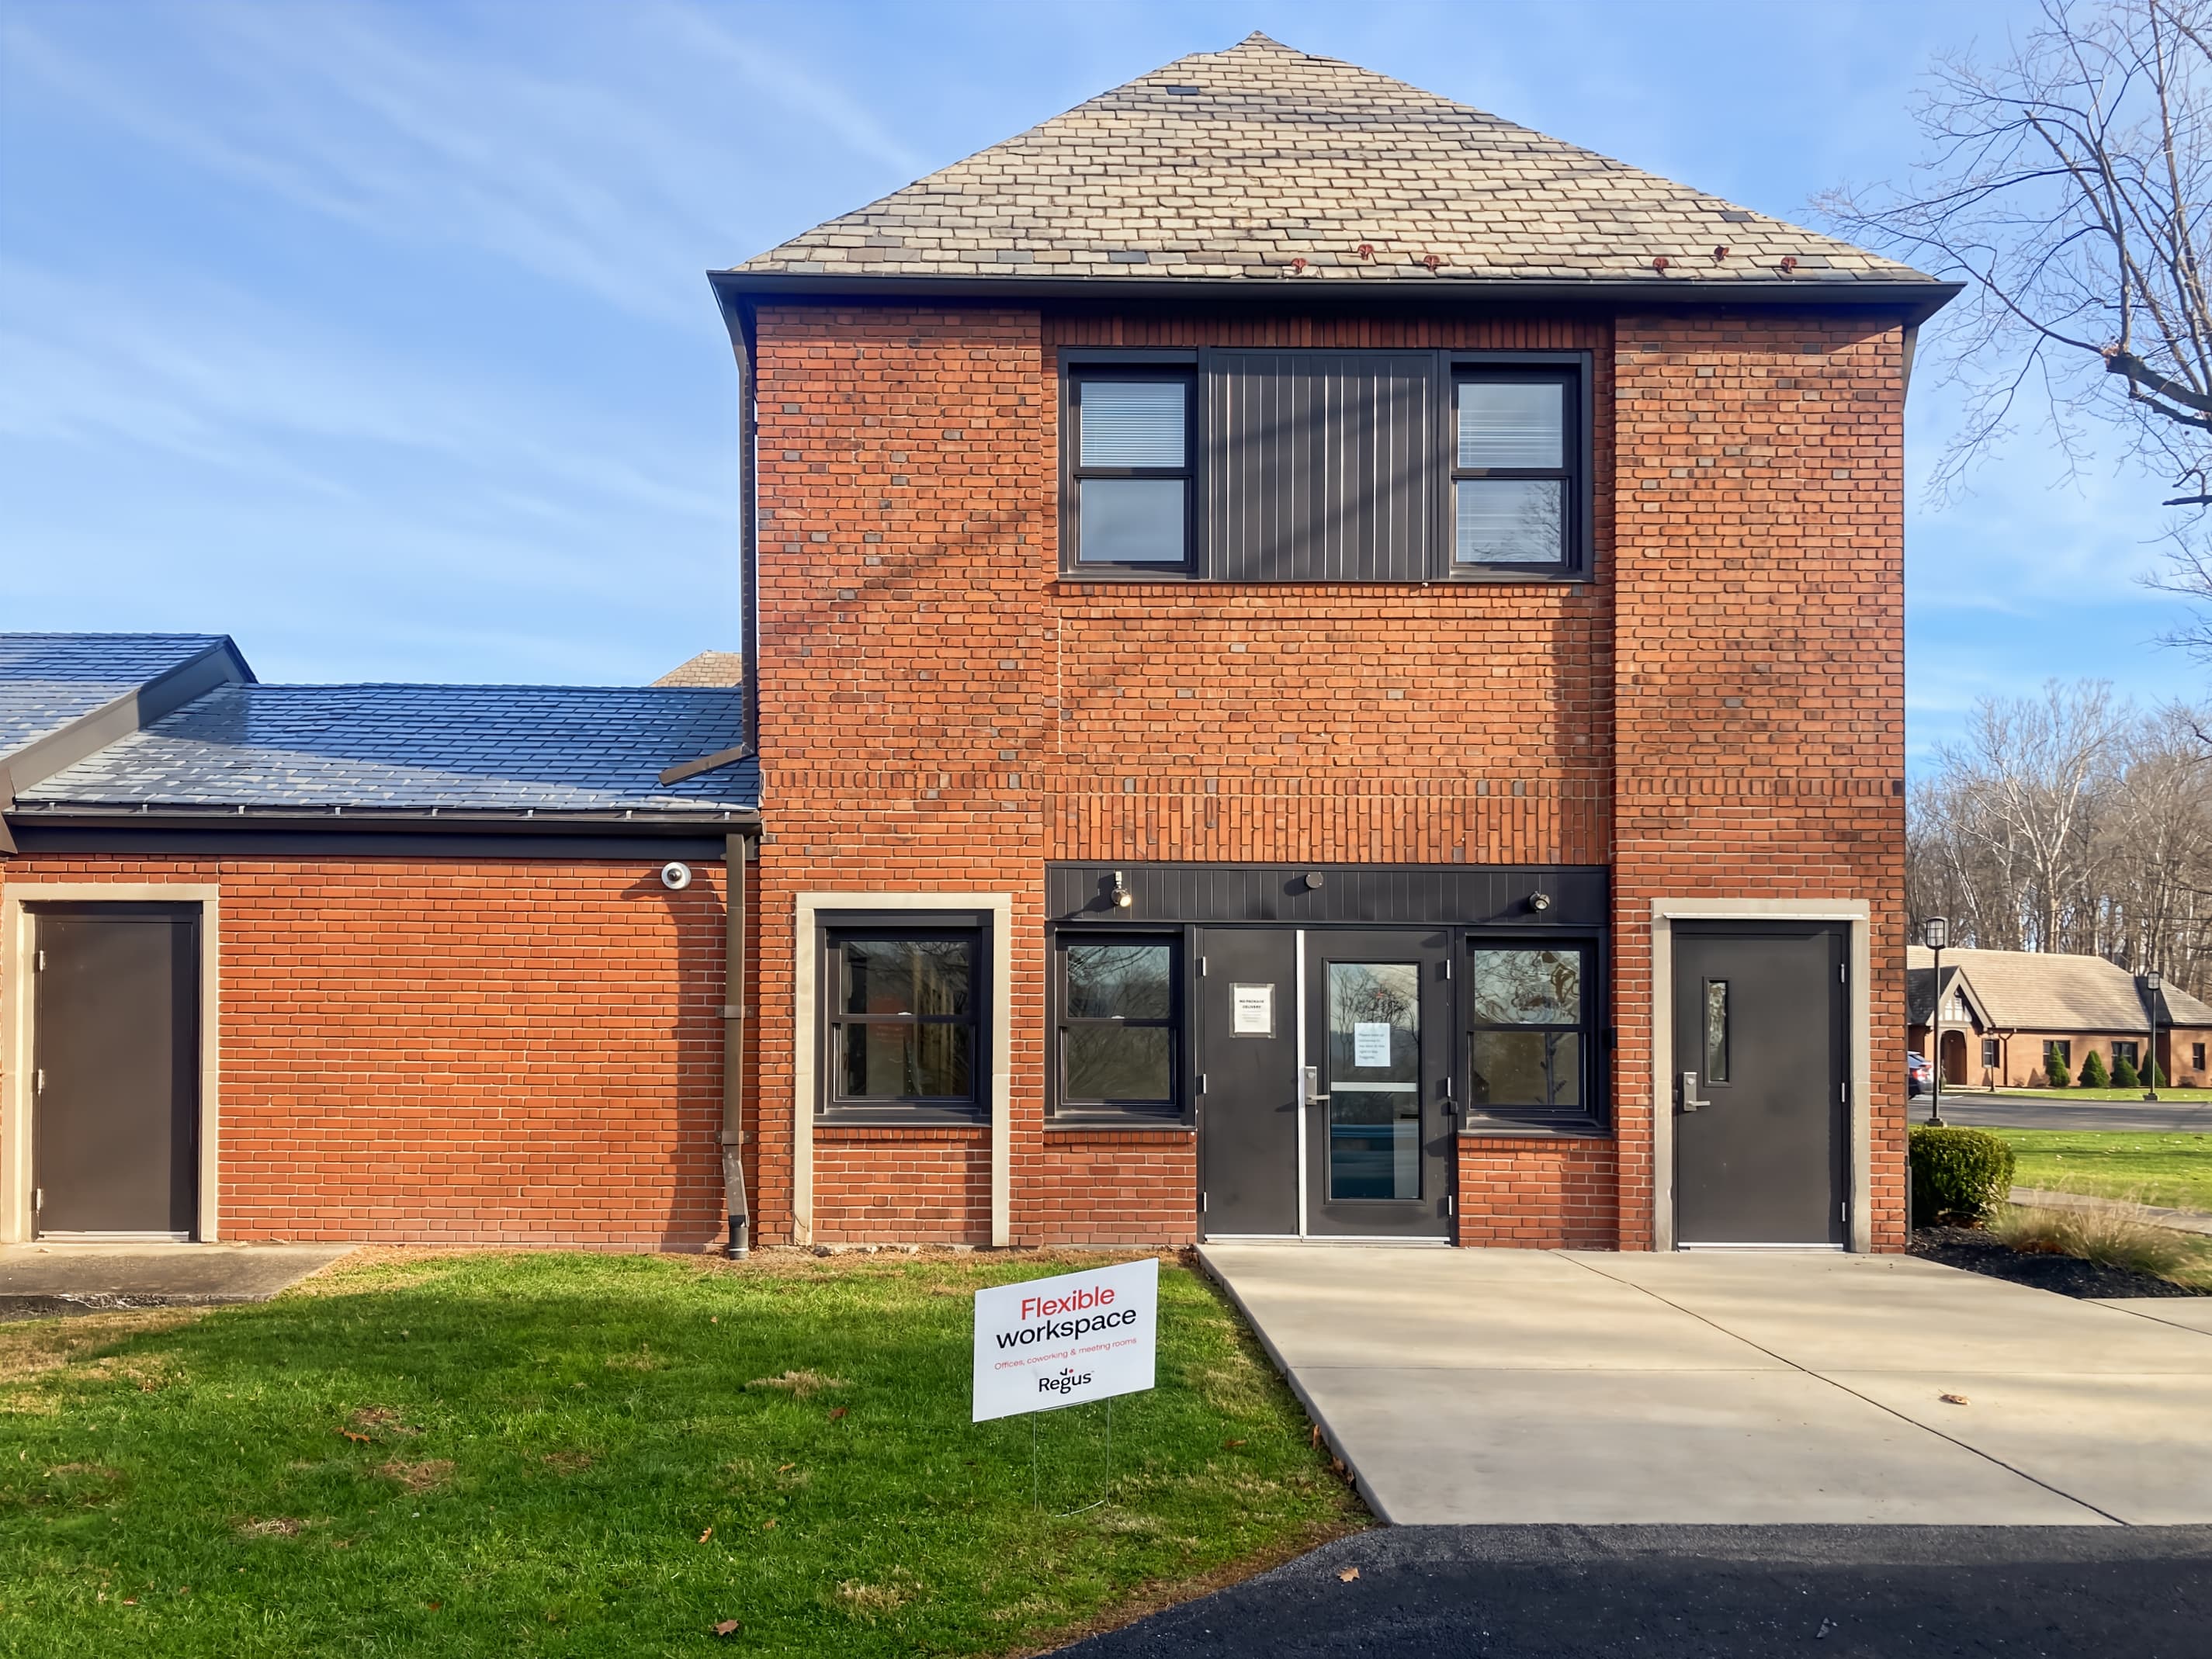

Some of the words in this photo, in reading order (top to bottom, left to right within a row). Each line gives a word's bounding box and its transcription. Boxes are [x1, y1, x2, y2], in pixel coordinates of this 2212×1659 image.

[1021, 1286, 1115, 1320] Flexible
[996, 1309, 1136, 1349] workspace
[994, 1358, 1025, 1370] Offices,
[1027, 1350, 1068, 1365] coworking
[1078, 1342, 1111, 1354] meeting
[1111, 1338, 1137, 1348] rooms
[1038, 1372, 1091, 1394] Regus
